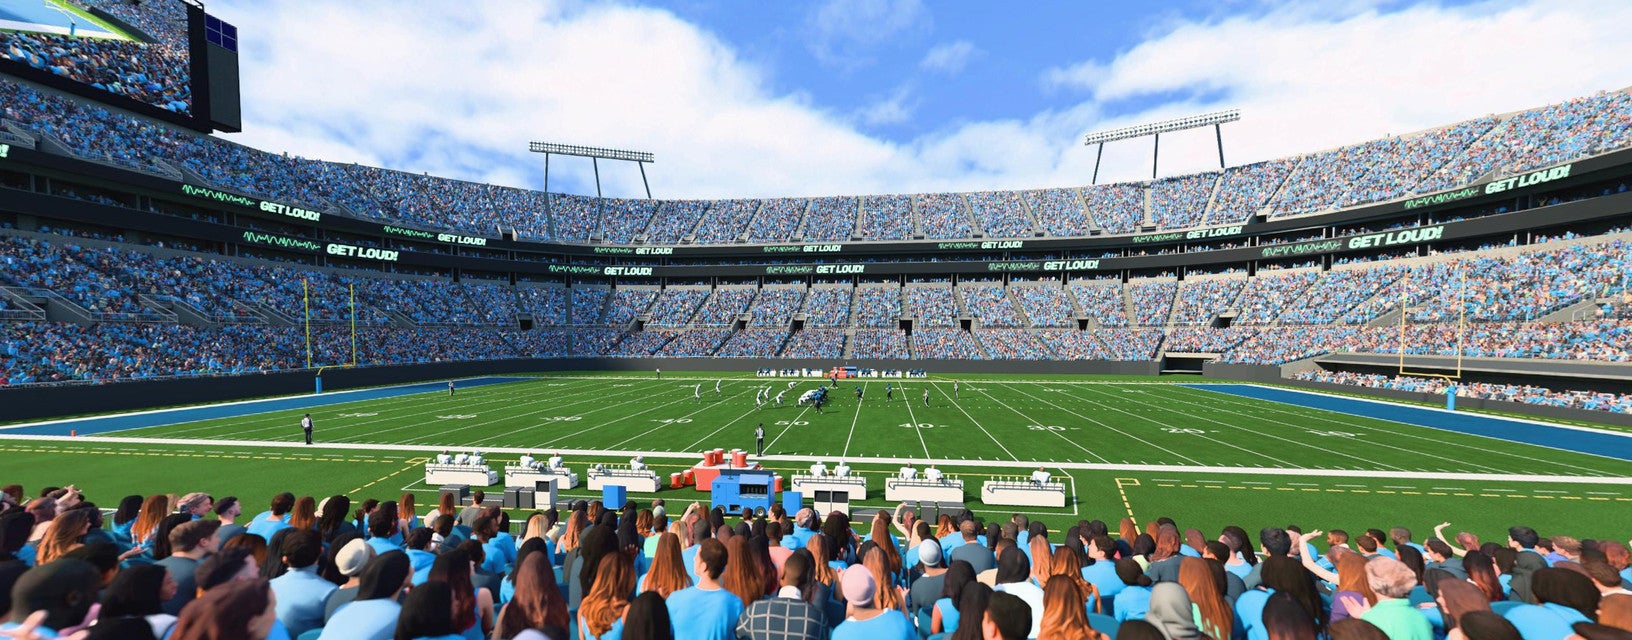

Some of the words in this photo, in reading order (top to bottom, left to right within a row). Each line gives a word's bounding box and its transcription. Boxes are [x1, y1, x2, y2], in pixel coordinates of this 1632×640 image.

[1485, 177, 1518, 194] GET
[1518, 164, 1572, 187] LOUD!
[260, 201, 285, 214] GET
[285, 206, 320, 221] LOUD!
[1186, 229, 1209, 239] GET
[1208, 226, 1242, 237] LOUD!
[1348, 234, 1385, 248] GET
[1385, 226, 1444, 245] LOUD!
[438, 233, 457, 243] GET
[457, 235, 486, 245] LOUD!
[981, 241, 998, 249] GET
[997, 240, 1023, 248] LOUD!
[326, 244, 357, 256] GET
[357, 247, 399, 261] LOUD!
[650, 247, 673, 255] LOUD!
[818, 244, 841, 252] LOUD!
[816, 265, 836, 273] GET
[835, 264, 864, 274] LOUD!
[1043, 261, 1065, 270] GET
[1065, 259, 1099, 270] LOUD!
[604, 266, 624, 275] GET
[623, 266, 652, 276] LOUD!
